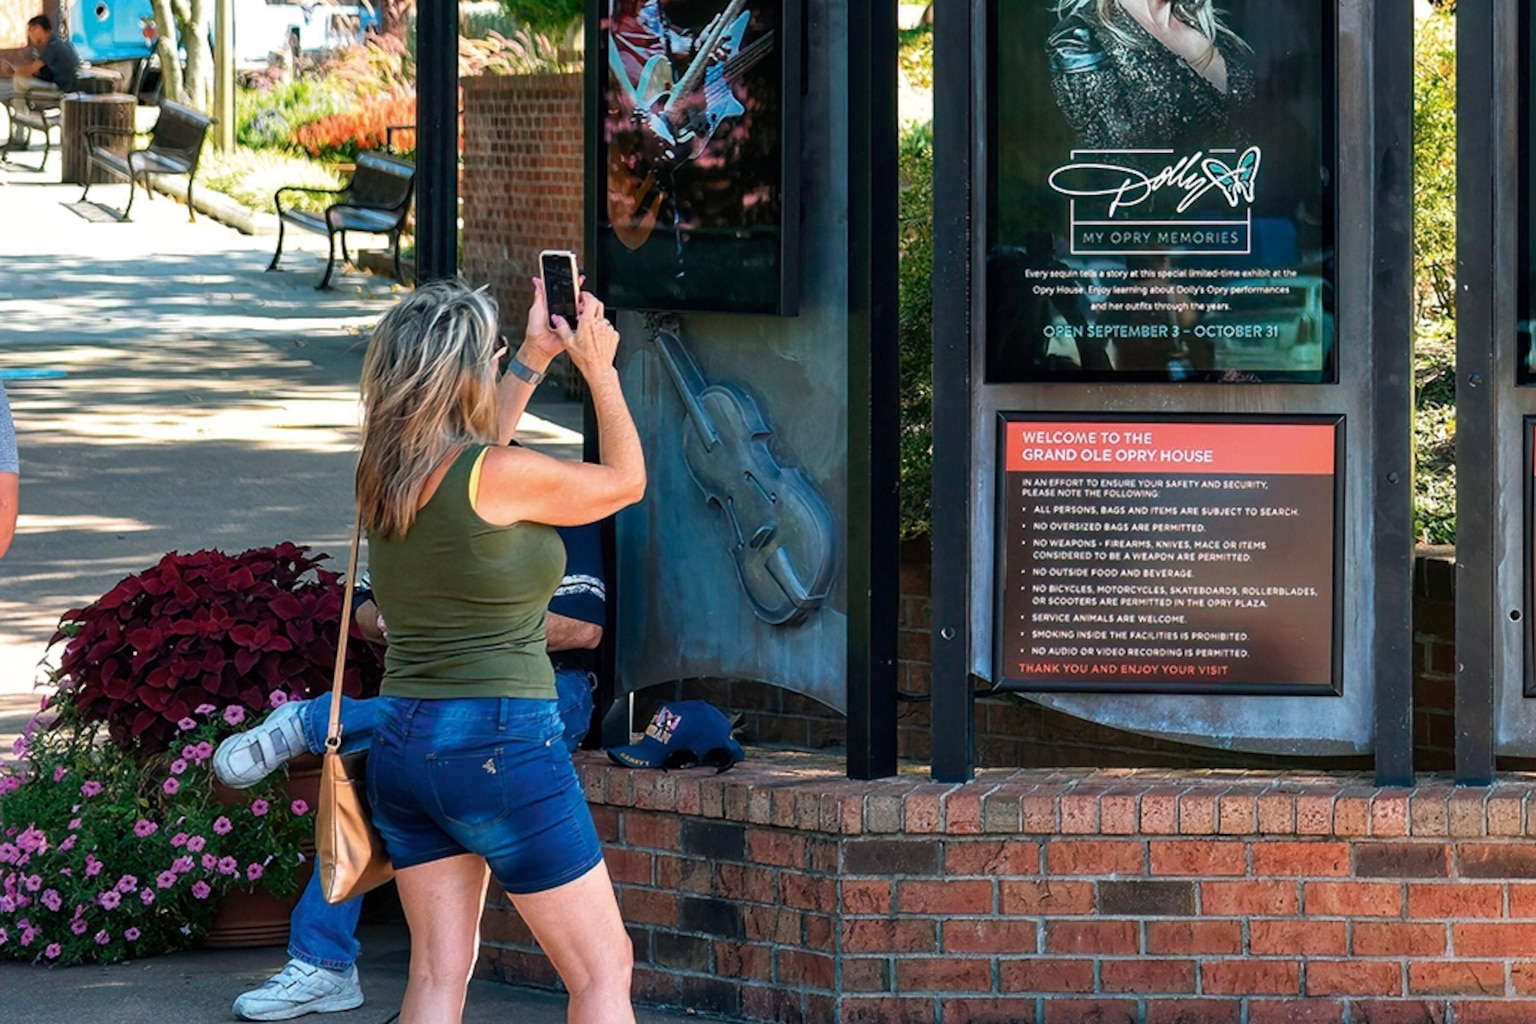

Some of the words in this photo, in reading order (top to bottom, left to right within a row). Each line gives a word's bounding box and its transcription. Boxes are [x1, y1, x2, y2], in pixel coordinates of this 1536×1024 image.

[1047, 150, 1221, 219] Dolly
[1082, 231, 1104, 243] MY
[1109, 230, 1151, 245] OPRY
[1157, 230, 1238, 244] MEMORIES
[1024, 268, 1049, 280] Every
[1049, 269, 1078, 279] sequin
[1079, 268, 1098, 281] tells
[1098, 270, 1105, 279] a
[1105, 266, 1129, 280] story
[1129, 269, 1139, 278] at
[1139, 268, 1156, 278] this
[1156, 268, 1187, 279] special
[1188, 268, 1240, 278] limited-time
[1241, 268, 1271, 278] exhibit
[1272, 269, 1281, 281] at
[1282, 268, 1297, 281] the
[1031, 284, 1055, 296] Opry
[1055, 283, 1087, 294] House.
[1087, 283, 1112, 297] Enjoy
[1112, 284, 1148, 296] learning
[1149, 284, 1174, 294] about
[1175, 284, 1205, 296] Dolly's
[1205, 284, 1229, 296] Opry
[1229, 283, 1290, 295] performances
[1089, 299, 1107, 311] and
[1107, 301, 1123, 311] her
[1124, 300, 1153, 311] outfits
[1153, 301, 1189, 312] through
[1189, 301, 1205, 311] the
[1205, 302, 1232, 313] years.
[1042, 324, 1083, 340] OPEN
[1086, 323, 1168, 340] SEPTEMBER
[1171, 324, 1180, 338] 3
[1193, 324, 1263, 340] OCTOBER
[1265, 324, 1278, 338] 31
[1022, 431, 1097, 445] WELCOME
[1100, 431, 1120, 445] TO
[1124, 431, 1153, 446] THE
[1021, 447, 1078, 461] GRAND
[1079, 447, 1112, 461] OLE
[1160, 448, 1213, 463] HOUSE
[1018, 662, 1060, 673] THANK
[1062, 662, 1088, 674] YOU
[1090, 663, 1117, 674] AND
[1120, 663, 1159, 674] ENJOY
[1161, 664, 1195, 675] YOUR
[1197, 664, 1228, 675] VISIT
